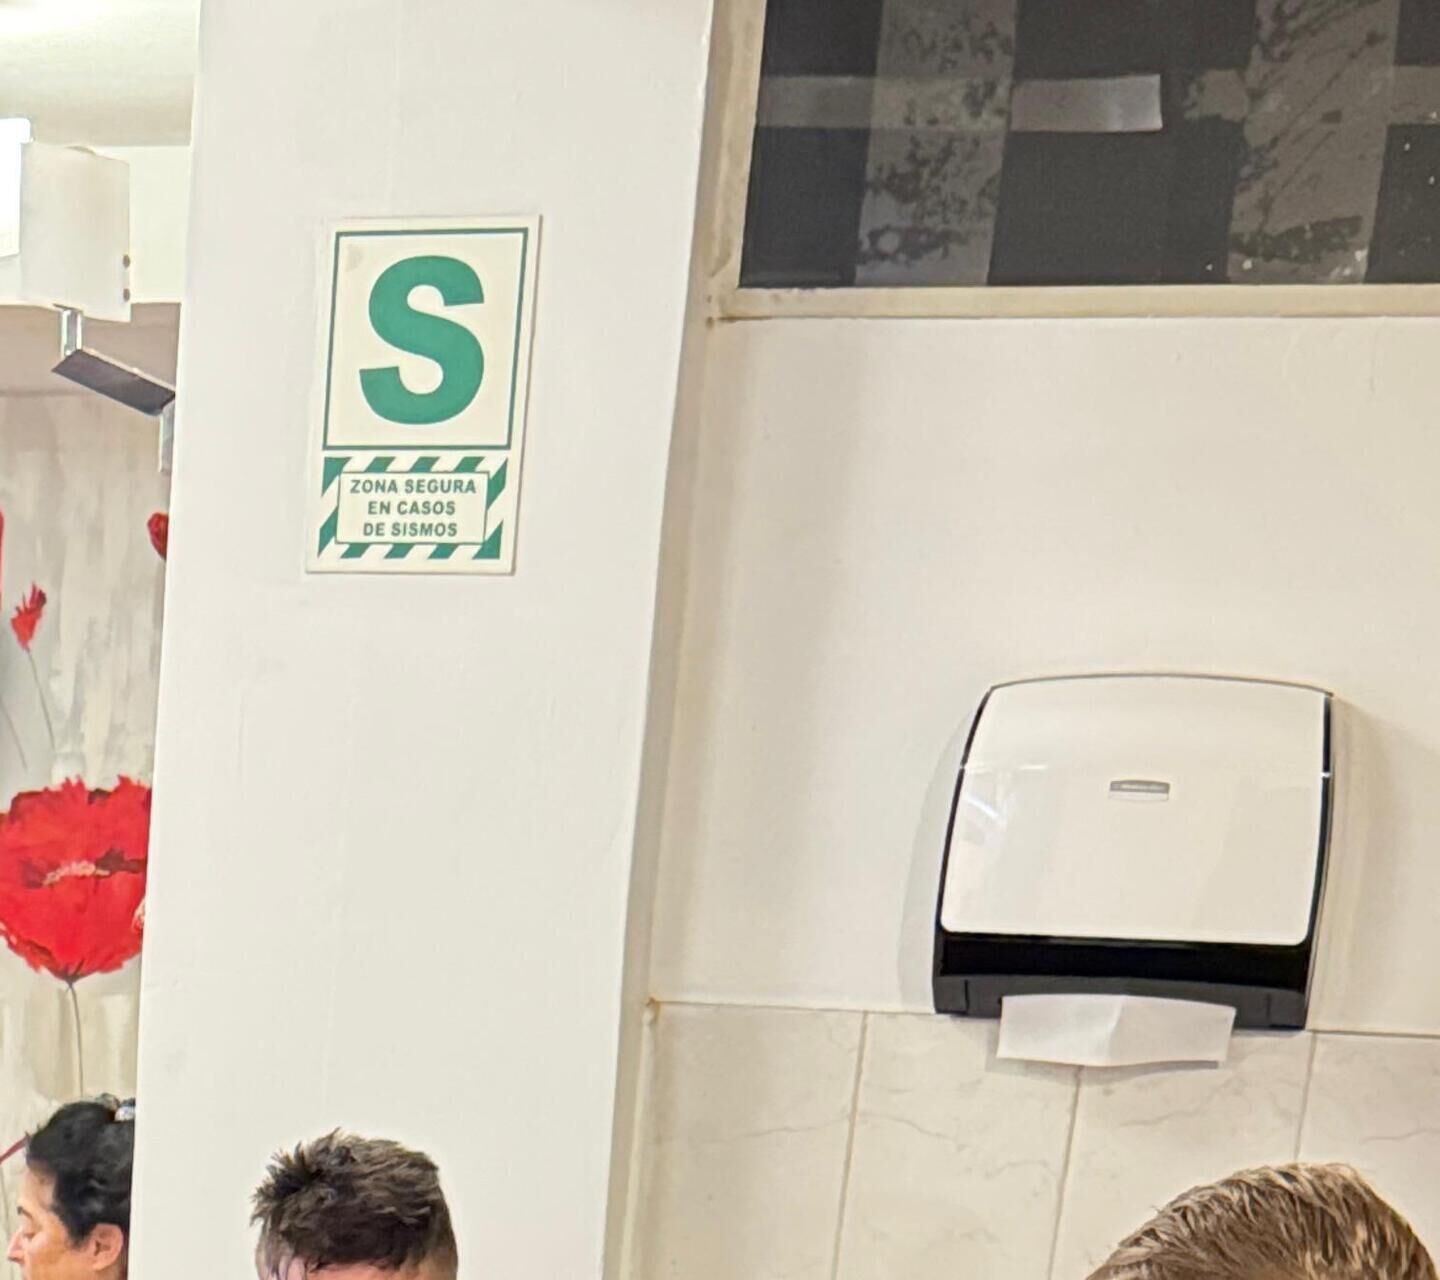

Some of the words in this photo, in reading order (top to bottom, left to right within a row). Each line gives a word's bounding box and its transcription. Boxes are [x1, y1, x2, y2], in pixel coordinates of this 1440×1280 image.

[359, 254, 485, 425] S
[349, 479, 398, 494] ZONA
[404, 479, 477, 494] SEGURA
[367, 501, 391, 515] EN
[396, 501, 456, 515] CASOS
[363, 523, 385, 536] DE
[391, 522, 458, 537] SISMOS
